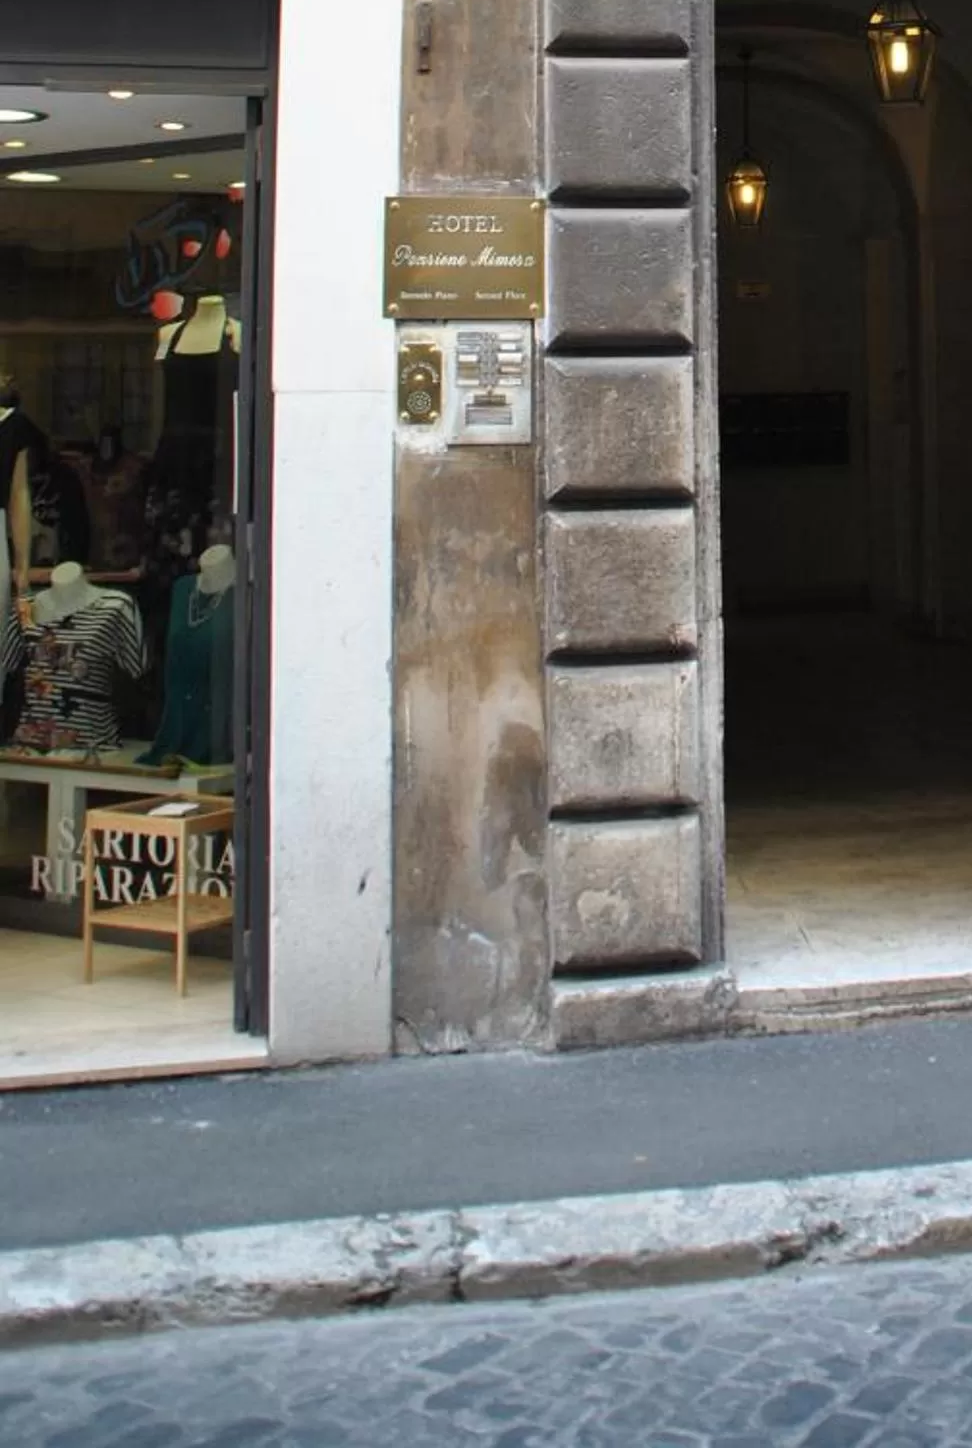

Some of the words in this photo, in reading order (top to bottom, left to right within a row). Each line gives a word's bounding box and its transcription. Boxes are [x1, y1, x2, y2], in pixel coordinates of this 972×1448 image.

[428, 215, 504, 233] HOTEL
[391, 244, 467, 267] Pensione
[470, 245, 535, 267] Mimosa
